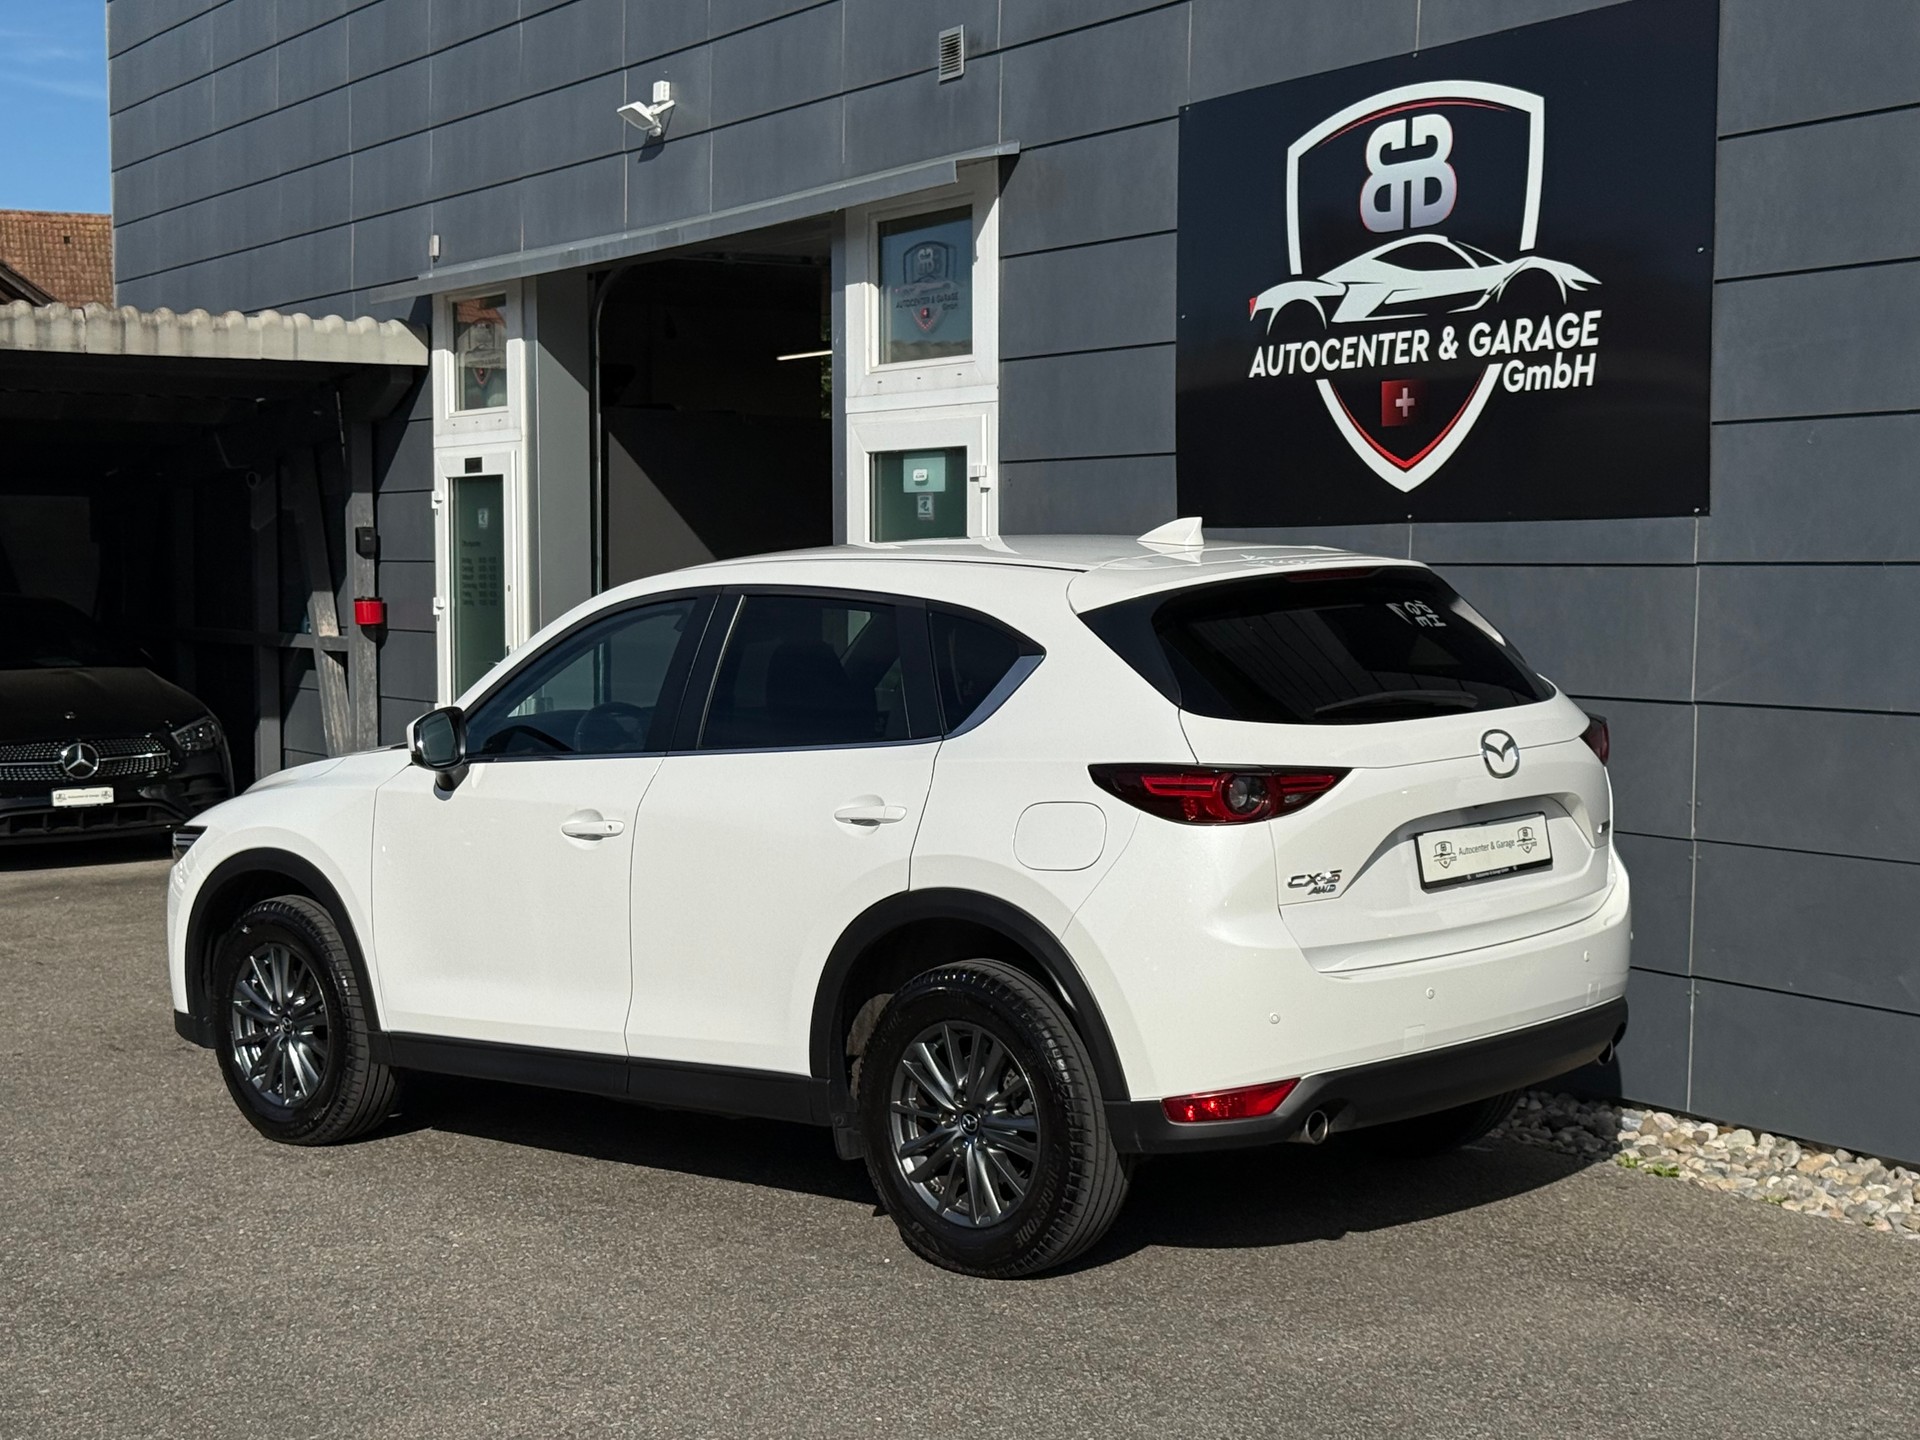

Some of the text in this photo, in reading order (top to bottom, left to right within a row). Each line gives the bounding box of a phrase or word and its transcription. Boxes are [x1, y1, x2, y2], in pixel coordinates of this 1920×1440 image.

[1248, 310, 1603, 378] AUTOCENTER & GARAGE
[1503, 351, 1597, 393] GmbH
[1459, 842, 1490, 855] Autocenter
[1496, 839, 1515, 850] Garage
[1287, 869, 1342, 889] CX-5
[1307, 884, 1336, 895] AWD
